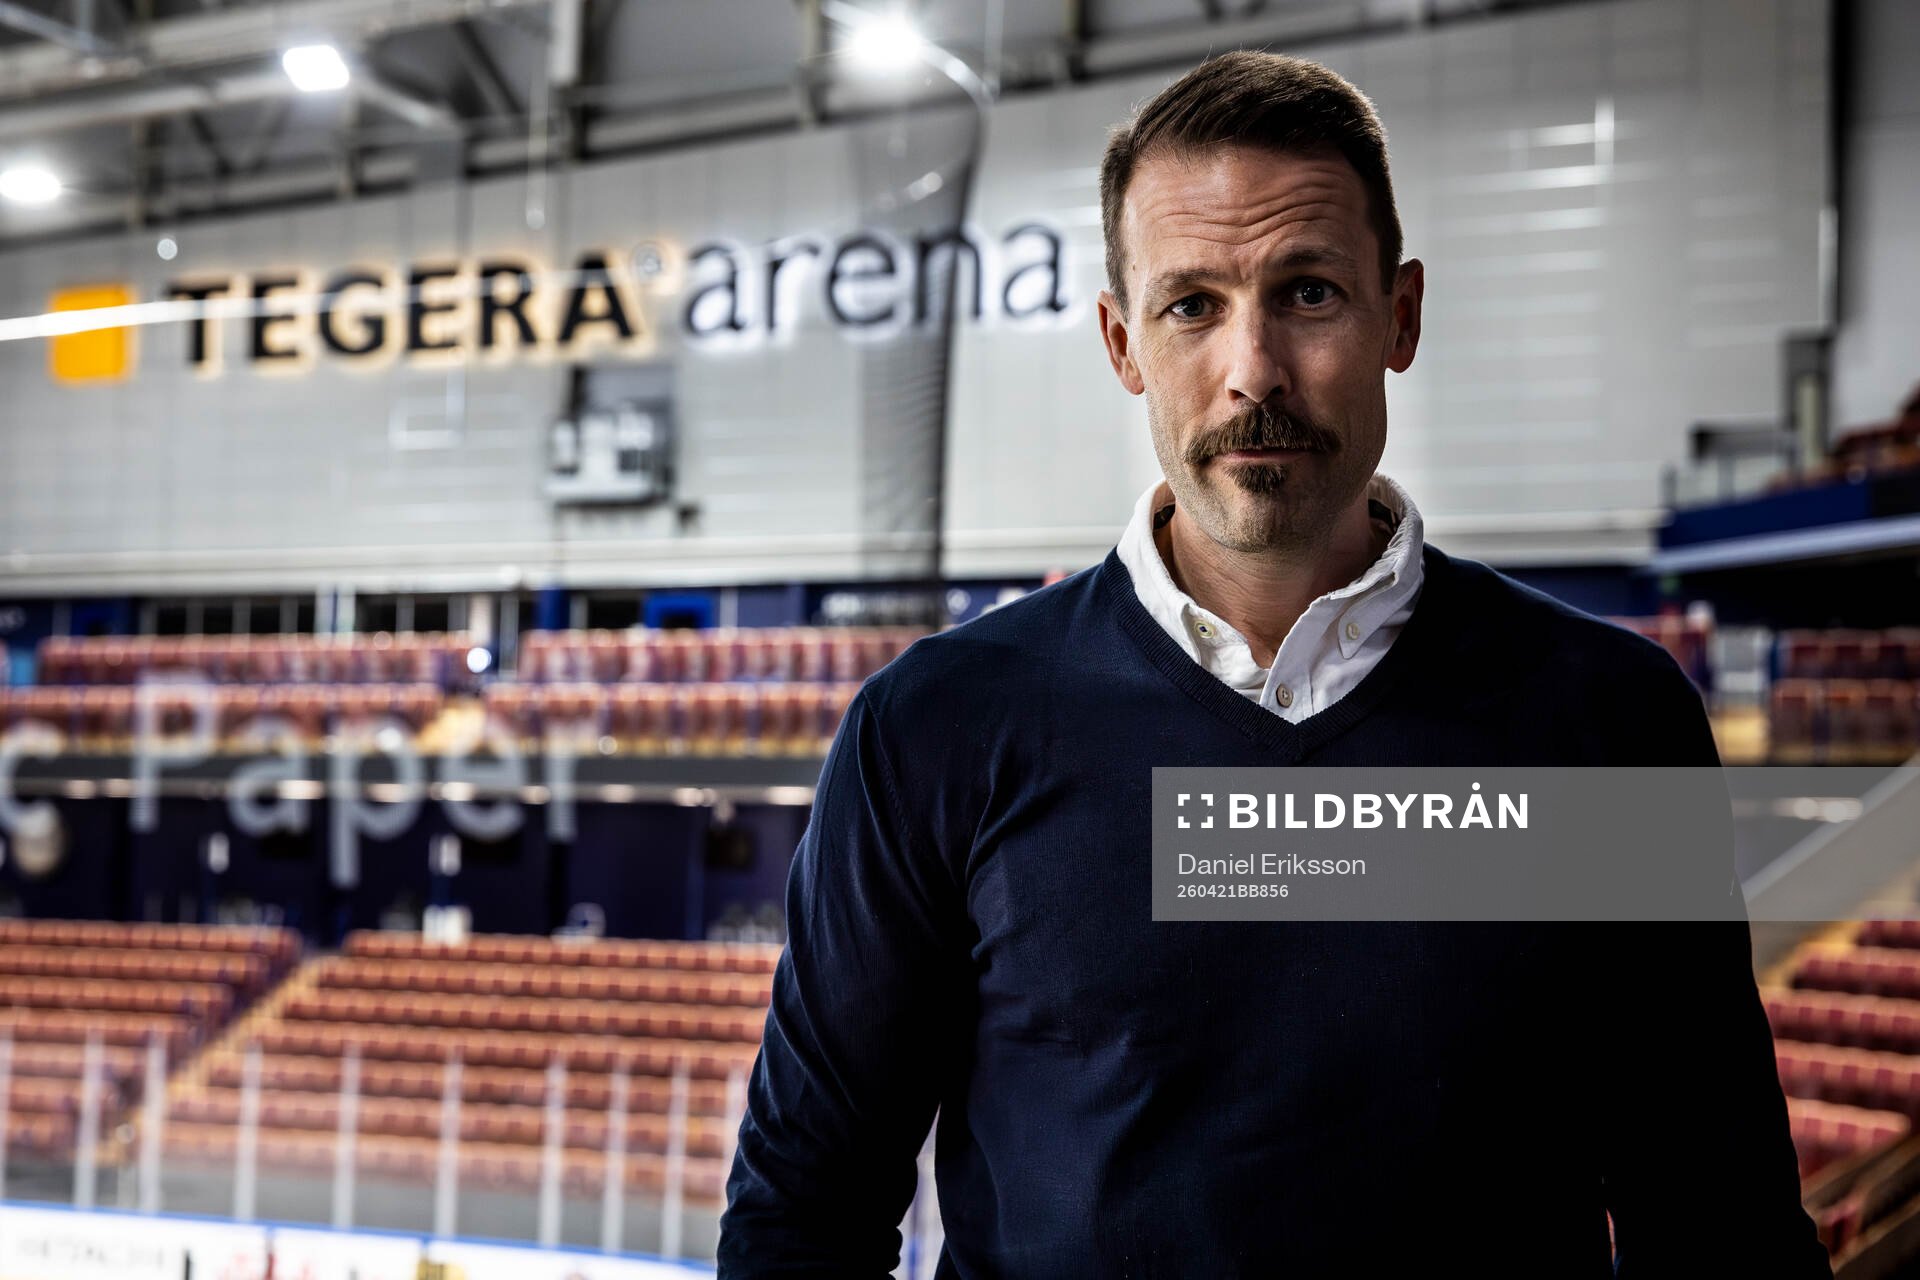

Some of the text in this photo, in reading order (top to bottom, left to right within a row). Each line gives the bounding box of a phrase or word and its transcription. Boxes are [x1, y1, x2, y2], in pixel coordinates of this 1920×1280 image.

[166, 222, 1068, 364] TEGERA arena
[130, 671, 598, 888] Paper
